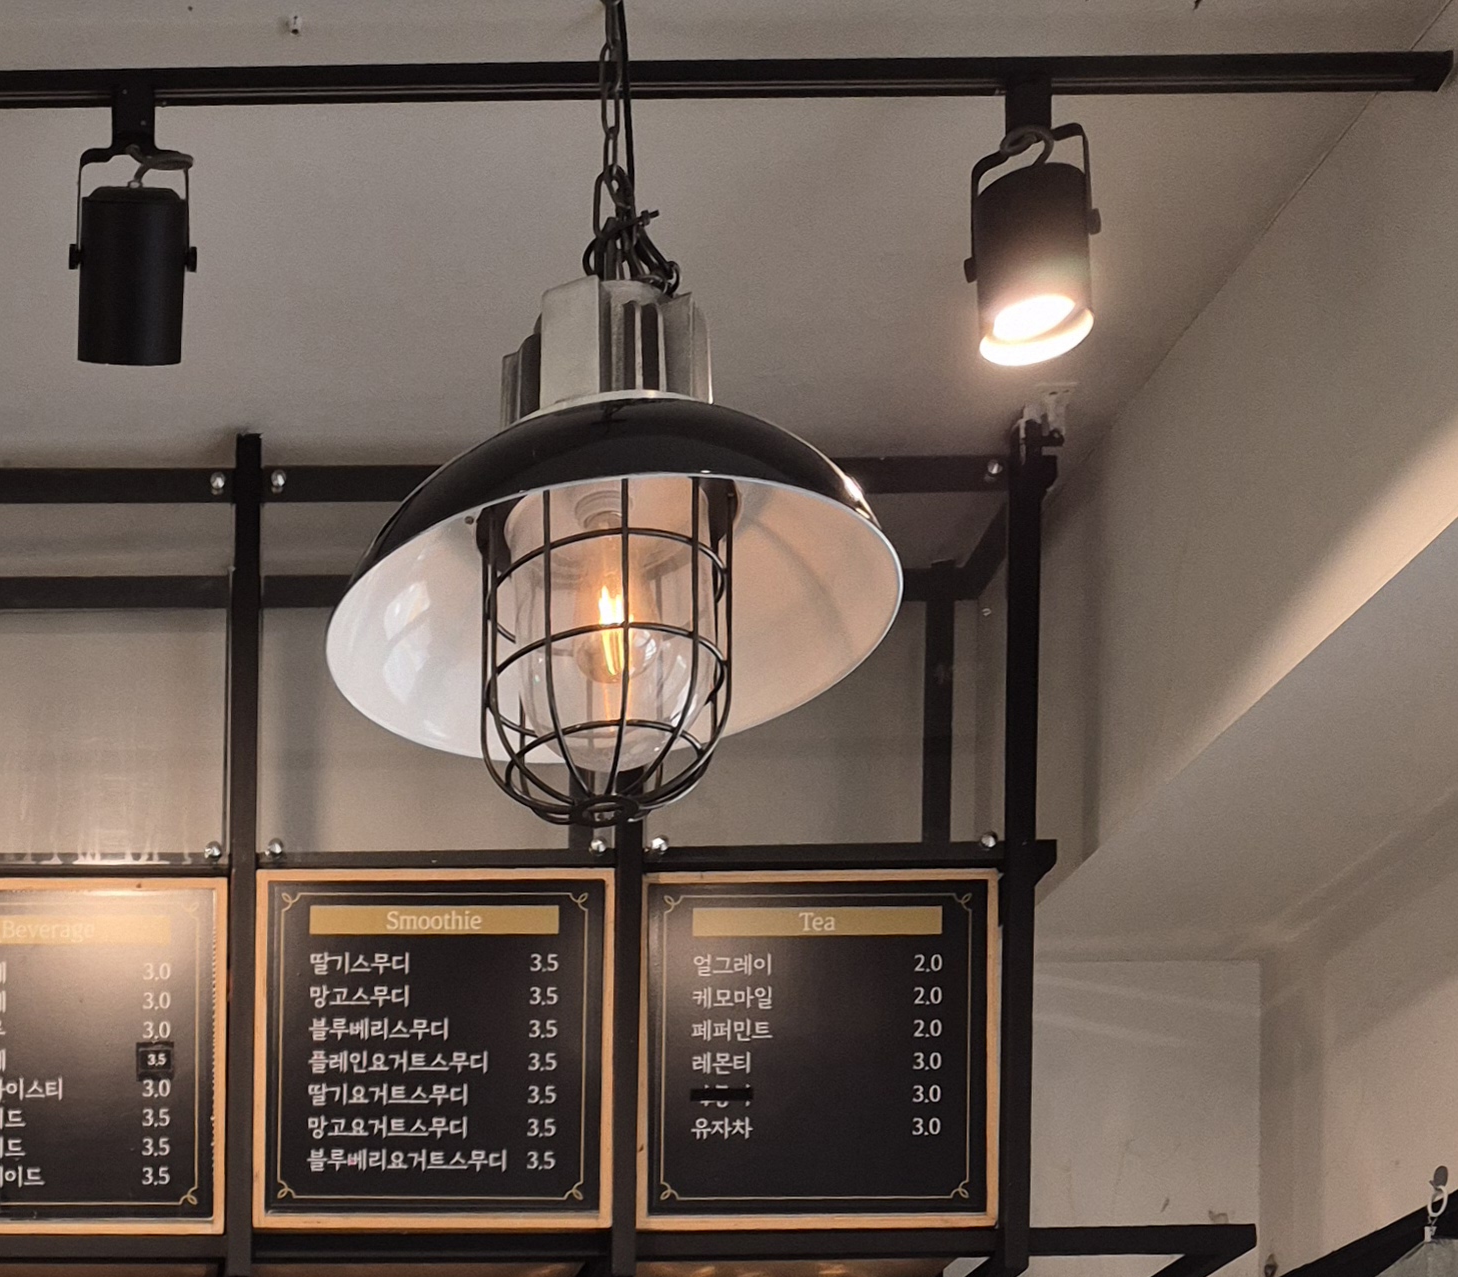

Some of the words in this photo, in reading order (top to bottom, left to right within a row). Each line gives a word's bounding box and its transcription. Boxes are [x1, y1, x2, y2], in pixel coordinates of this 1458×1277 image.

[1, 919, 95, 943] Beverage
[386, 910, 483, 932] Smoothie
[798, 912, 836, 932] Tea
[142, 962, 171, 981] 3.0
[309, 951, 411, 976] 딸기스무디
[529, 953, 560, 973] 3.5
[692, 953, 773, 977] 얼그레이
[913, 954, 943, 974] 2.0
[142, 991, 171, 1011] 3.0
[309, 984, 410, 1009] 망고스무디
[529, 986, 559, 1006] 3.5
[692, 986, 774, 1010] 케모마일
[913, 987, 943, 1006] 2.0
[142, 1020, 171, 1040] 3.0
[308, 1017, 450, 1041] 블루베리스무디
[528, 1019, 558, 1039] 3.5
[691, 1019, 774, 1042] 페퍼민트
[912, 1019, 943, 1039] 2.0
[307, 1050, 489, 1075] 플레인요거트스무디
[527, 1052, 558, 1072] 3.5
[692, 1051, 752, 1075] 레몬티
[912, 1052, 942, 1071] 3.0
[142, 1079, 171, 1099] 3.0
[307, 1082, 469, 1107] 딸기요거트스무디
[527, 1085, 557, 1105] 3.5
[911, 1084, 942, 1104] 3.0
[141, 1108, 171, 1128] 3.5
[307, 1115, 468, 1140] 망고요거트스무디
[526, 1117, 556, 1138] 3.5
[691, 1116, 754, 1140] 유자차
[911, 1117, 942, 1137] 3.0
[141, 1137, 171, 1157] 3.5
[306, 1148, 508, 1173] 블루베리요거트스무디
[525, 1151, 556, 1171] 3.5
[141, 1166, 171, 1186] 3.5
